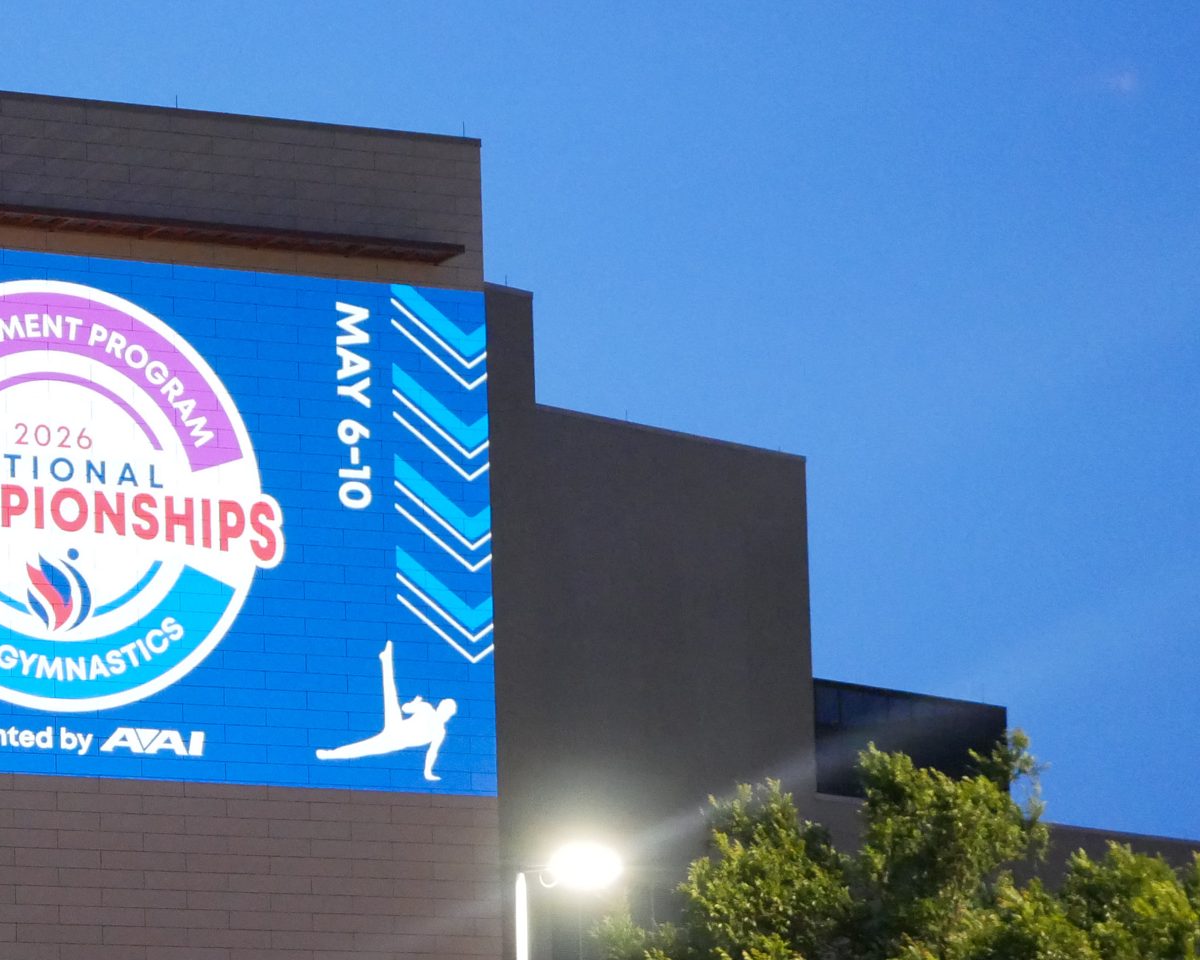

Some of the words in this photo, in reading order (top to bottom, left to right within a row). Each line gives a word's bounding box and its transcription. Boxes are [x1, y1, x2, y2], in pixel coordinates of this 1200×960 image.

[88, 324, 214, 448] PROGRAM
[335, 301, 371, 409] MAY
[14, 423, 93, 450] 2026
[337, 418, 372, 510] 6-10
[59, 726, 93, 755] by
